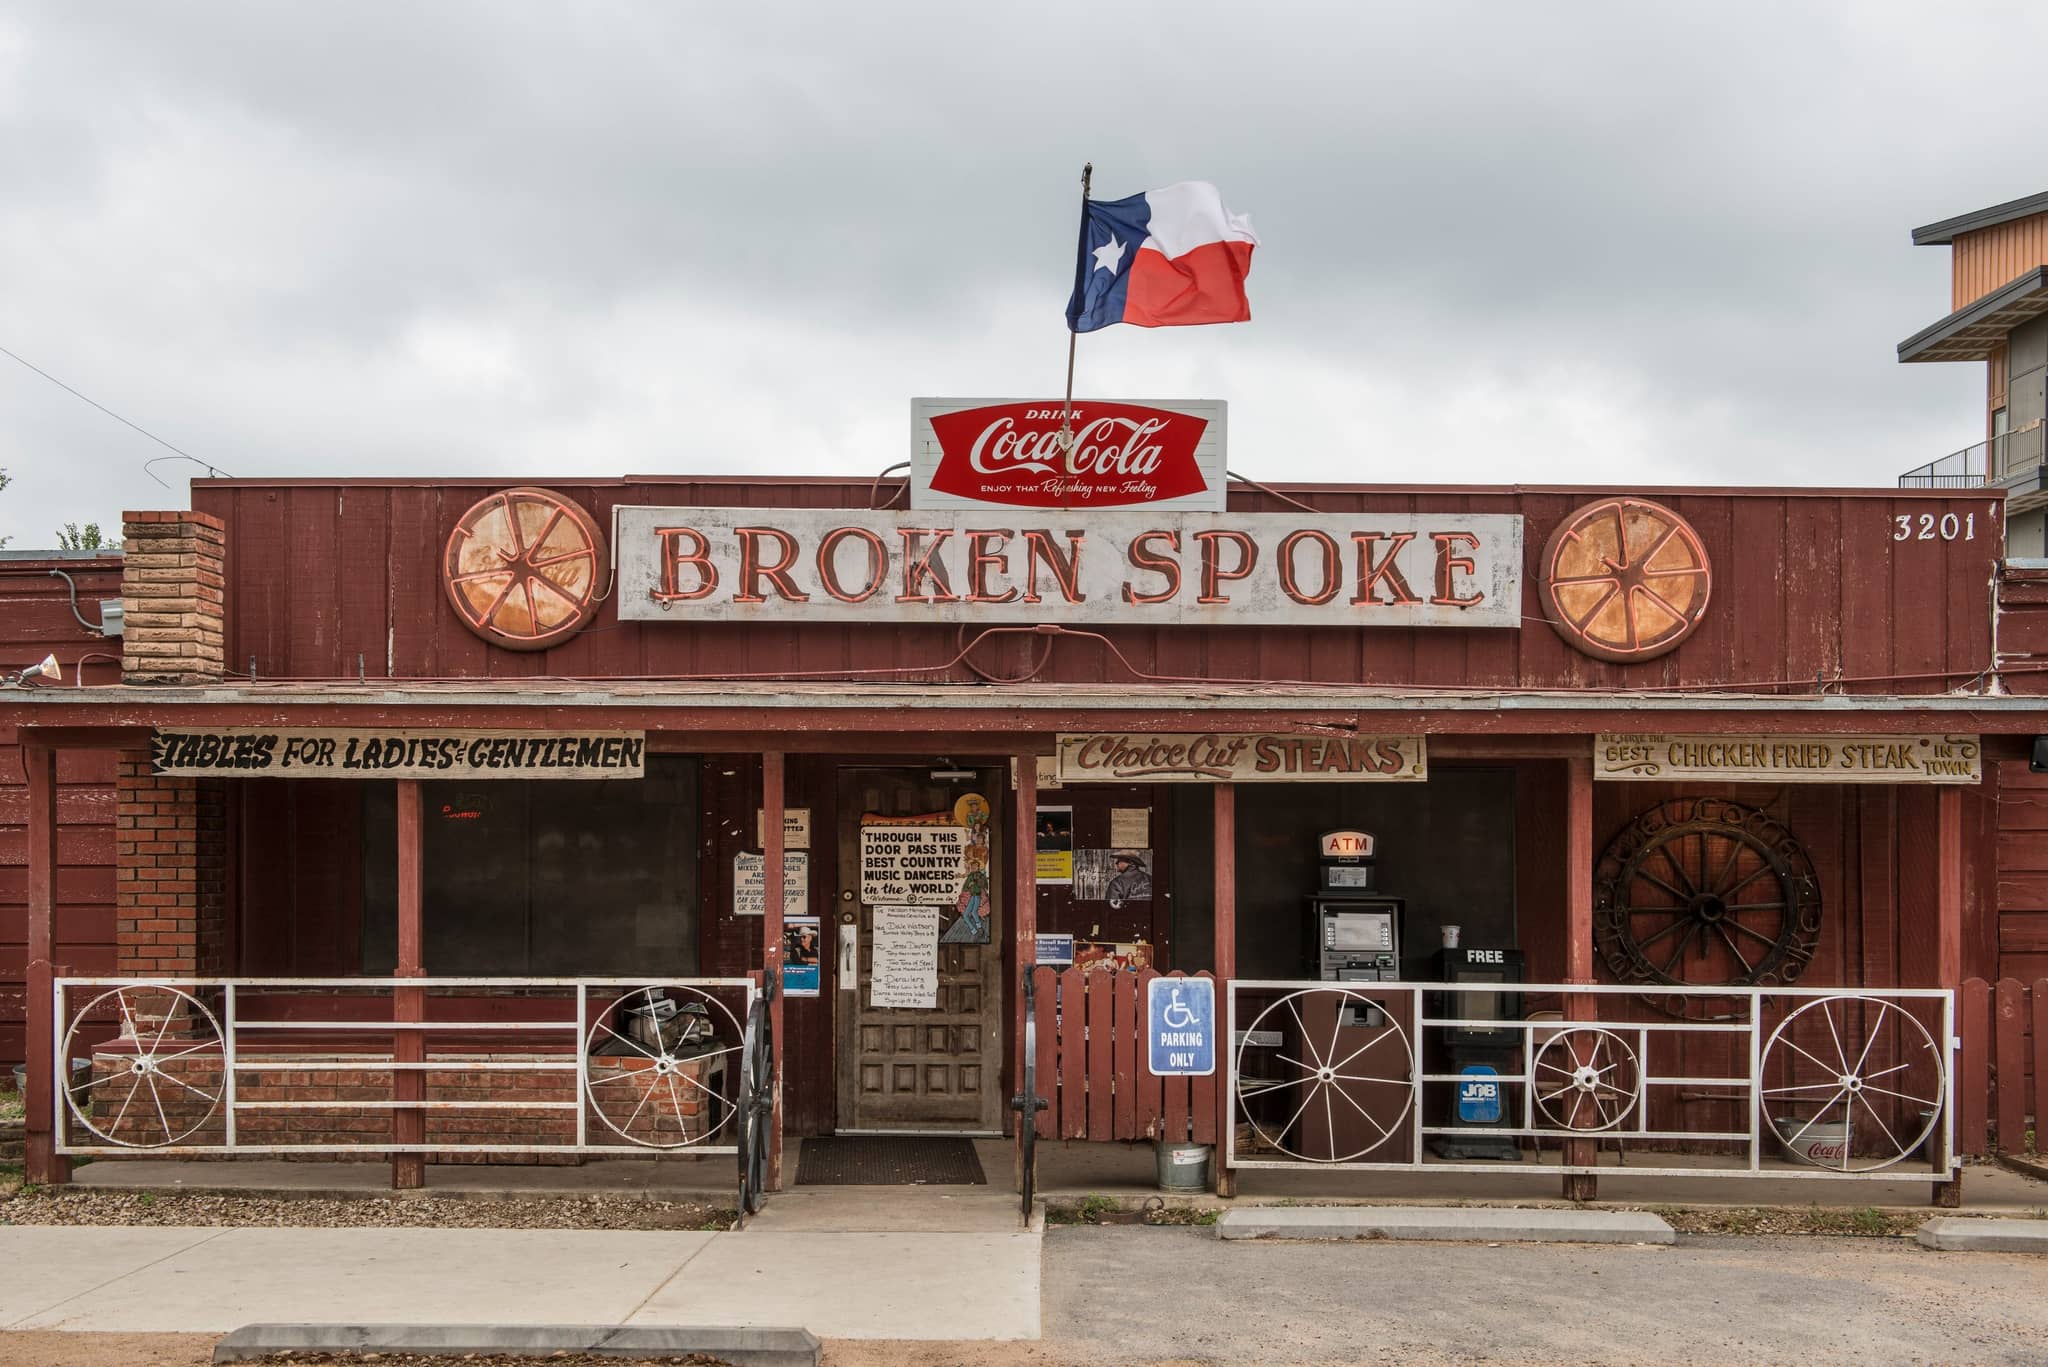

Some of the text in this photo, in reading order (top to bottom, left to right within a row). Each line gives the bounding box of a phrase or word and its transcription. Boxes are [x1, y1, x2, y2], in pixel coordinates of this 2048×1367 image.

[981, 485, 1012, 493] ENJOY
[1040, 479, 1093, 498] Refreshing
[1096, 485, 1117, 493] NEW
[1119, 480, 1157, 498] Feeling
[1894, 512, 1975, 541] 3201
[650, 526, 1086, 603] BROKEN
[1122, 529, 1485, 607] SPOKE
[159, 733, 278, 769] TABLES
[281, 738, 337, 767] FOR
[342, 738, 460, 769] LADIES
[468, 737, 646, 769] GENTLEMEN
[1078, 734, 1405, 775] Choice Cut STEAKS
[1606, 746, 1655, 761] BEST
[1668, 742, 1919, 770] CHICKEN FRIED STEAK
[1934, 745, 1953, 758] IN
[1922, 759, 1972, 776] TOWN
[931, 832, 957, 842] THIS
[1330, 838, 1368, 850] ATM
[865, 845, 961, 854] DOOR PASS THE
[866, 857, 961, 868] BEST COUNTRY
[864, 871, 954, 880] MUSIC DANCERS
[864, 883, 879, 894] in
[881, 883, 907, 894] the
[1467, 950, 1504, 963] FREE
[1161, 1032, 1203, 1047] PARKING
[1170, 1053, 1195, 1067] ONLY
